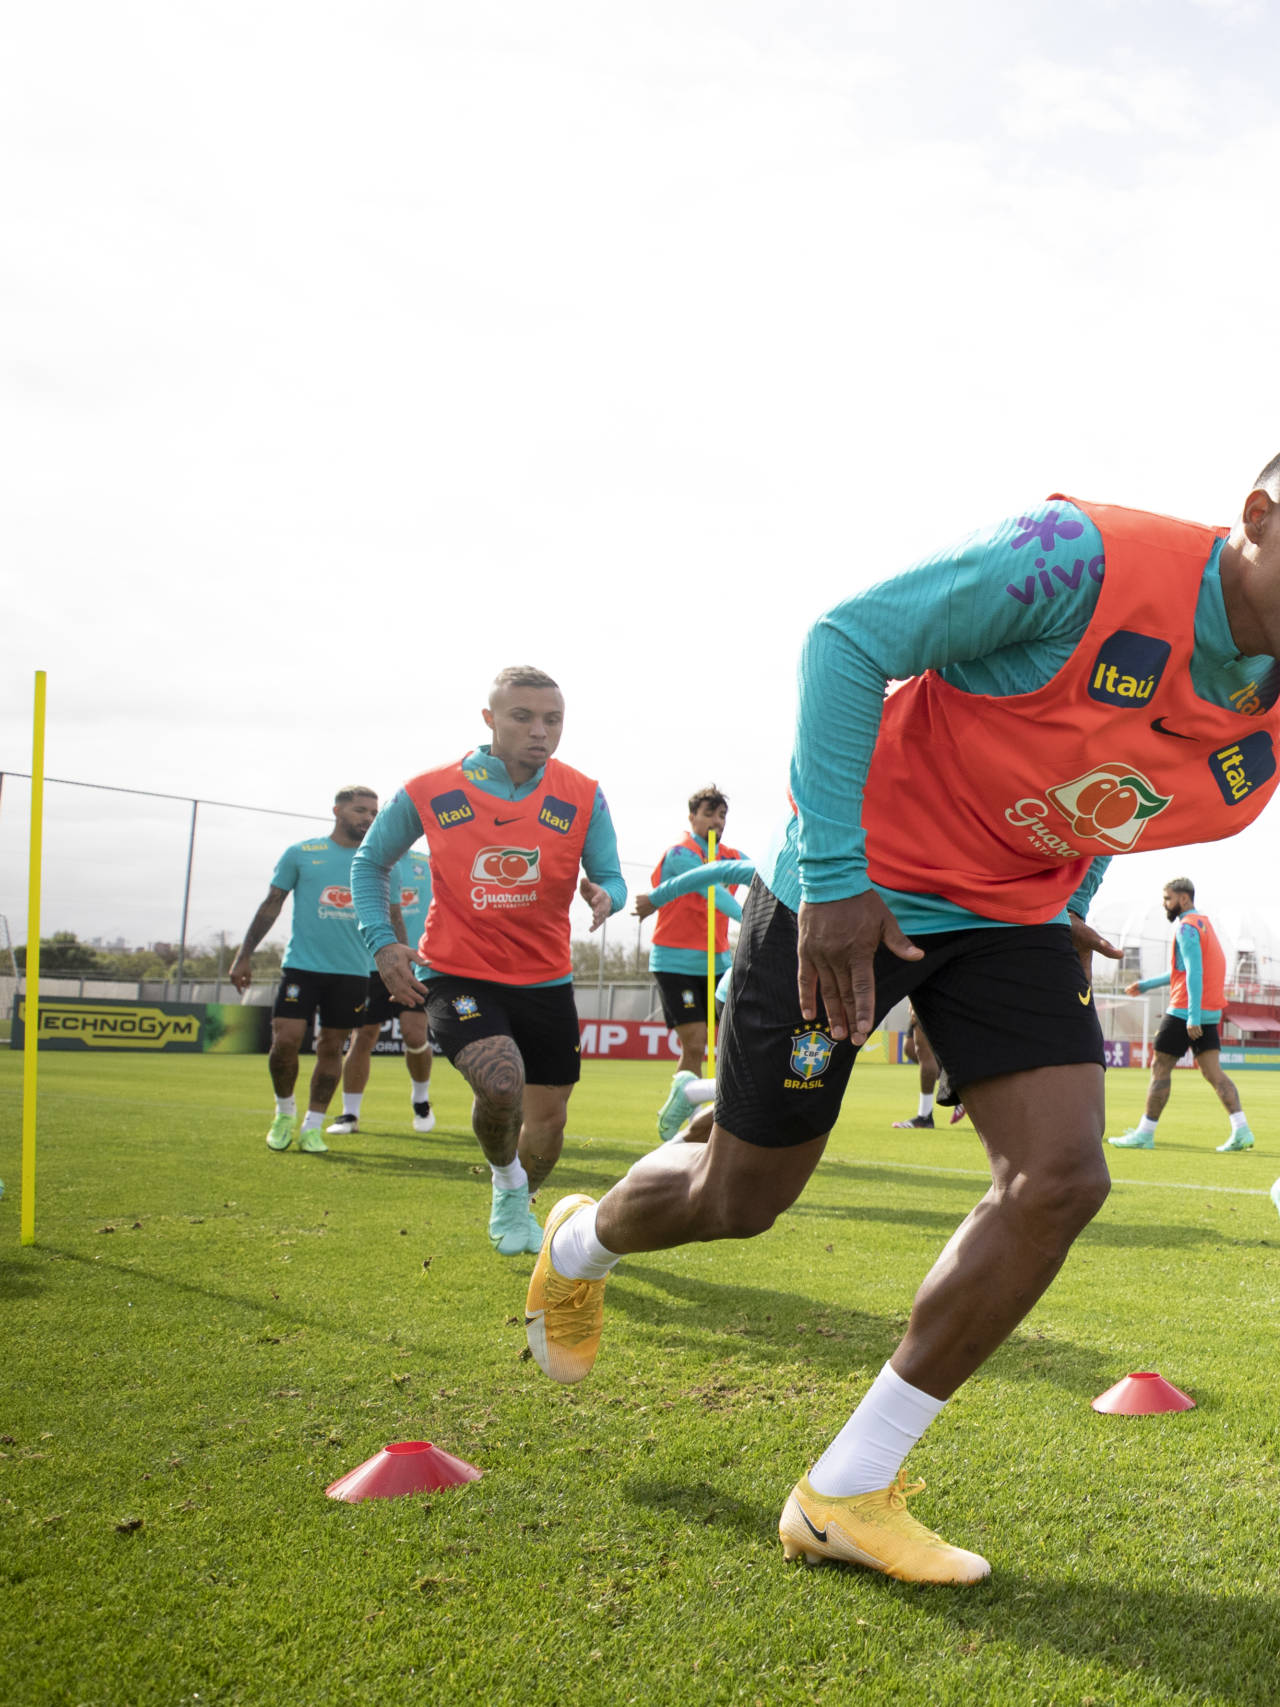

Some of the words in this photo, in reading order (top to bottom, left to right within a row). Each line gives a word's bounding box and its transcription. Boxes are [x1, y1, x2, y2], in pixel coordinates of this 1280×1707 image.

[1093, 663, 1155, 699] Itaú
[462, 767, 489, 781] aú
[1217, 746, 1253, 800] Itaú
[438, 804, 473, 826] Itaú
[540, 807, 570, 832] Itaú
[470, 886, 538, 911] Guaraná
[784, 1079, 825, 1090] BRASIL
